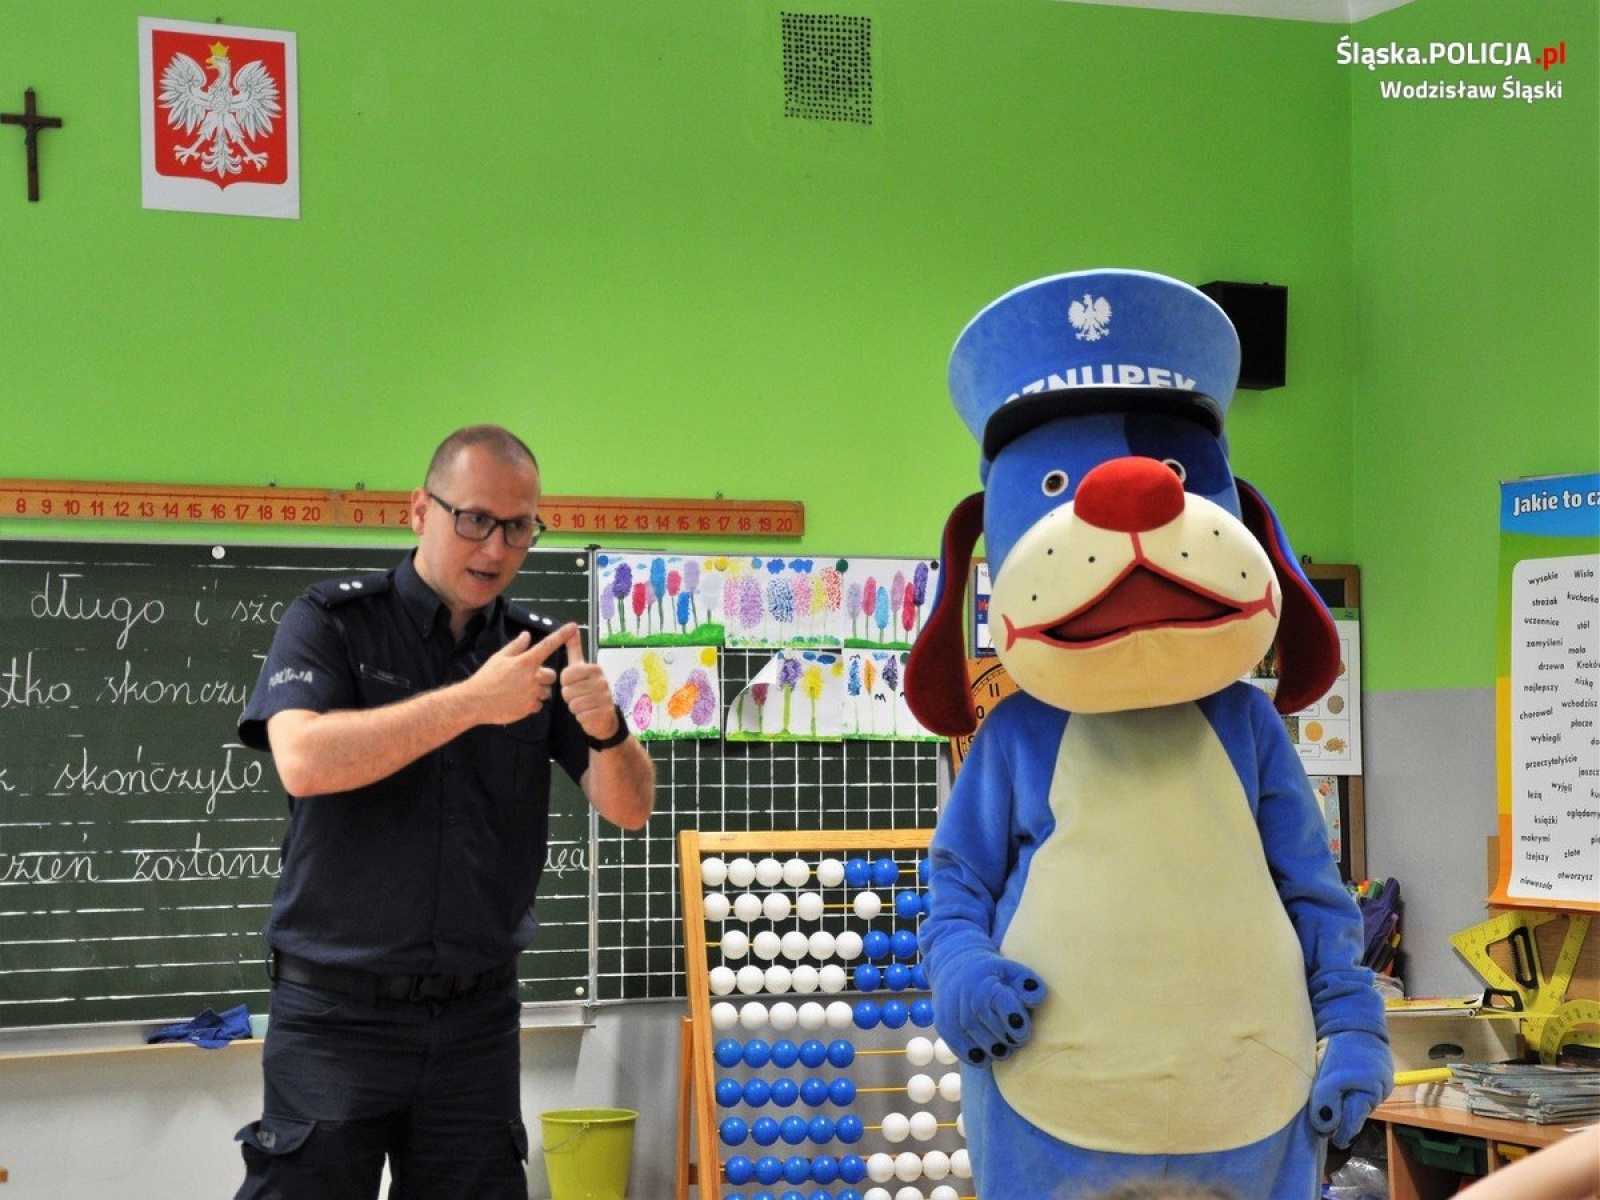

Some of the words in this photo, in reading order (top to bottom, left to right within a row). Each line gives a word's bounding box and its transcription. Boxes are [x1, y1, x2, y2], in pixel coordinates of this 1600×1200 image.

[16, 498, 26, 514] 8
[41, 499, 52, 514] 9
[63, 499, 81, 516] 10
[90, 500, 104, 516] 11
[113, 501, 130, 517] 12
[138, 502, 154, 517] 13
[163, 502, 179, 518] 14
[186, 502, 202, 519] 15
[210, 503, 226, 519] 16
[234, 503, 250, 520] 17
[257, 504, 273, 521] 18
[280, 505, 297, 521] 19
[302, 506, 321, 522] 20
[1512, 491, 1558, 517] Jakie
[1563, 490, 1582, 509] to
[353, 508, 364, 524] 0
[378, 509, 385, 524] 1
[399, 509, 409, 525] 2
[552, 513, 561, 528] 9
[571, 513, 585, 529] 10
[593, 514, 606, 529] 11
[613, 514, 629, 529] 12
[634, 515, 649, 530] 13
[655, 514, 671, 531] 14
[675, 515, 690, 531] 15
[696, 515, 711, 531] 16
[716, 515, 731, 532] 17
[736, 516, 752, 532] 18
[757, 516, 772, 532] 19
[775, 517, 794, 533] 20
[1528, 571, 1559, 586] wysokie
[31, 571, 165, 650] długo
[194, 586, 209, 626] i
[1523, 617, 1560, 626] uczennice
[1523, 682, 1559, 693] najlepszy
[1561, 699, 1598, 708] wchodzisz
[1530, 733, 1562, 744] wybiegli
[54, 744, 262, 814] skończyło
[1520, 833, 1551, 845] mokrymi
[1557, 872, 1593, 882] otworzysz
